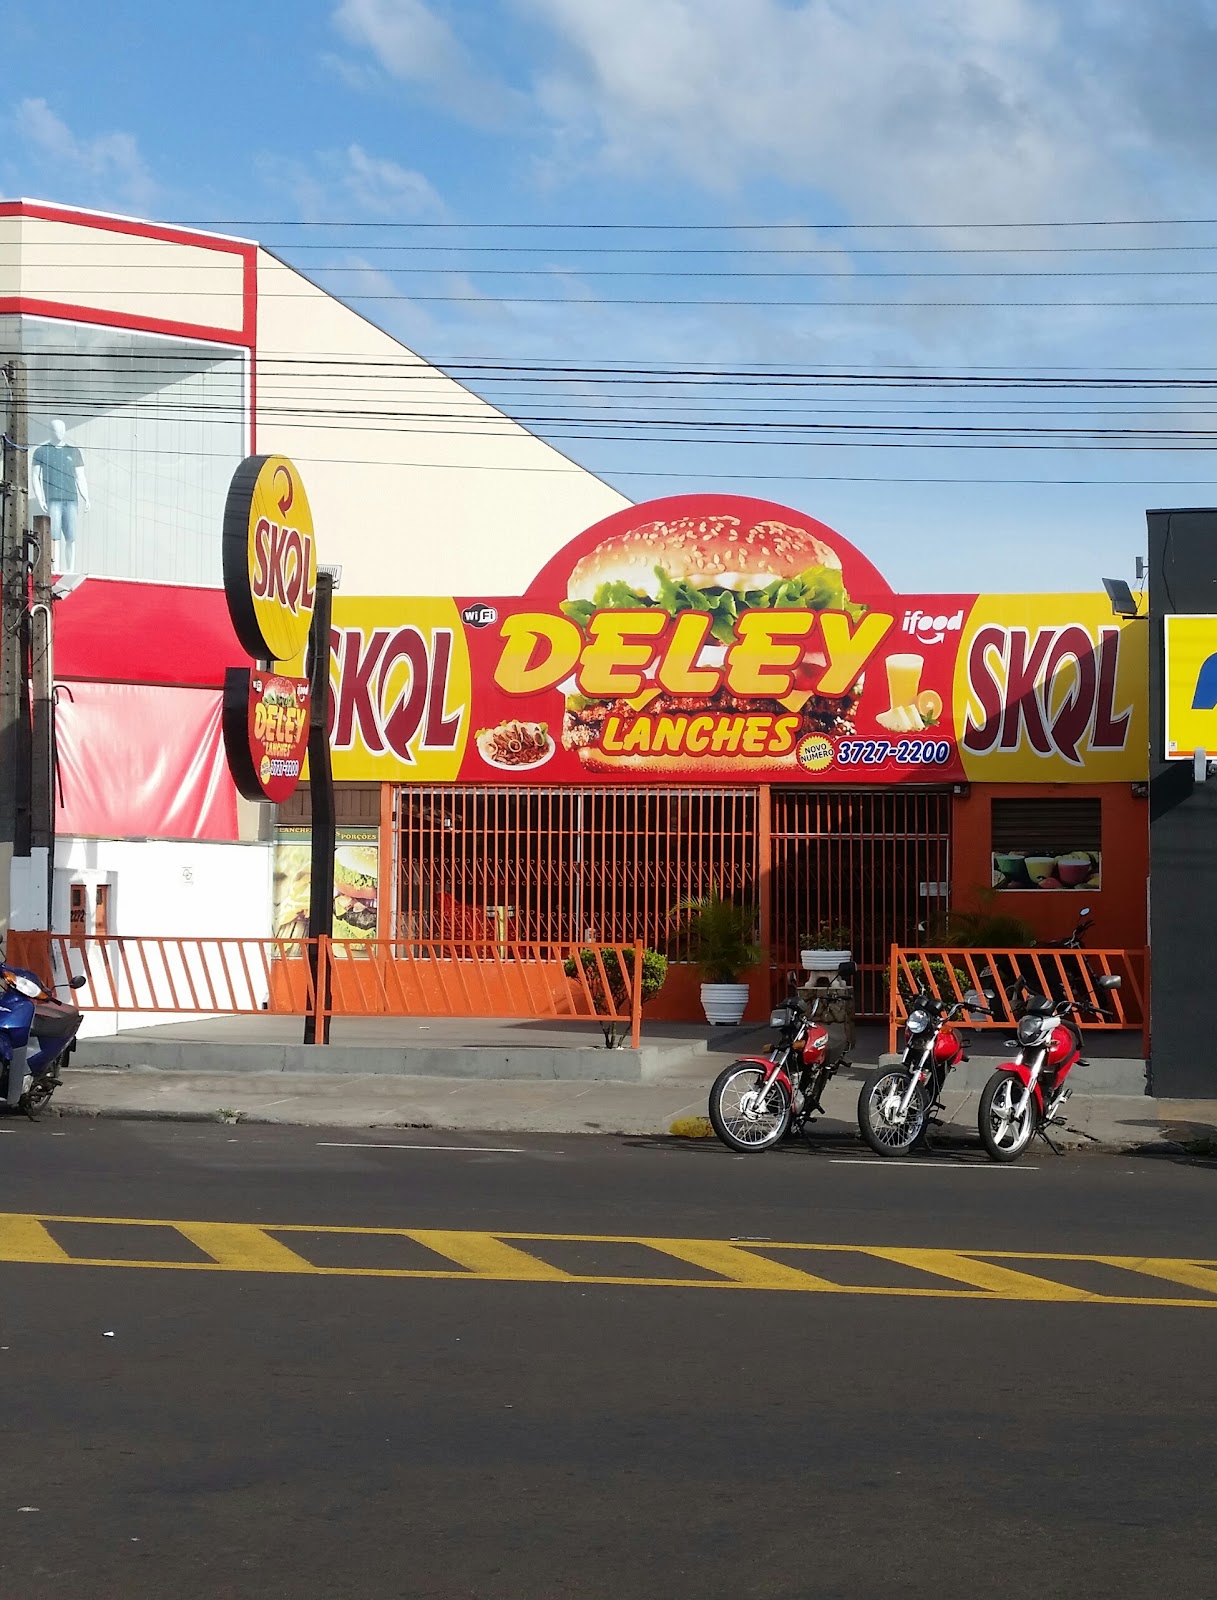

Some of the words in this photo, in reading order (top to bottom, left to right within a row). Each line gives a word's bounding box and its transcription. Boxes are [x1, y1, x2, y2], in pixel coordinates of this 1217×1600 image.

[493, 610, 895, 697] DELEY
[254, 702, 306, 744] DELEY
[602, 715, 799, 756] LANCHES
[804, 743, 827, 754] NOVO
[837, 740, 950, 764] 3727-2200
